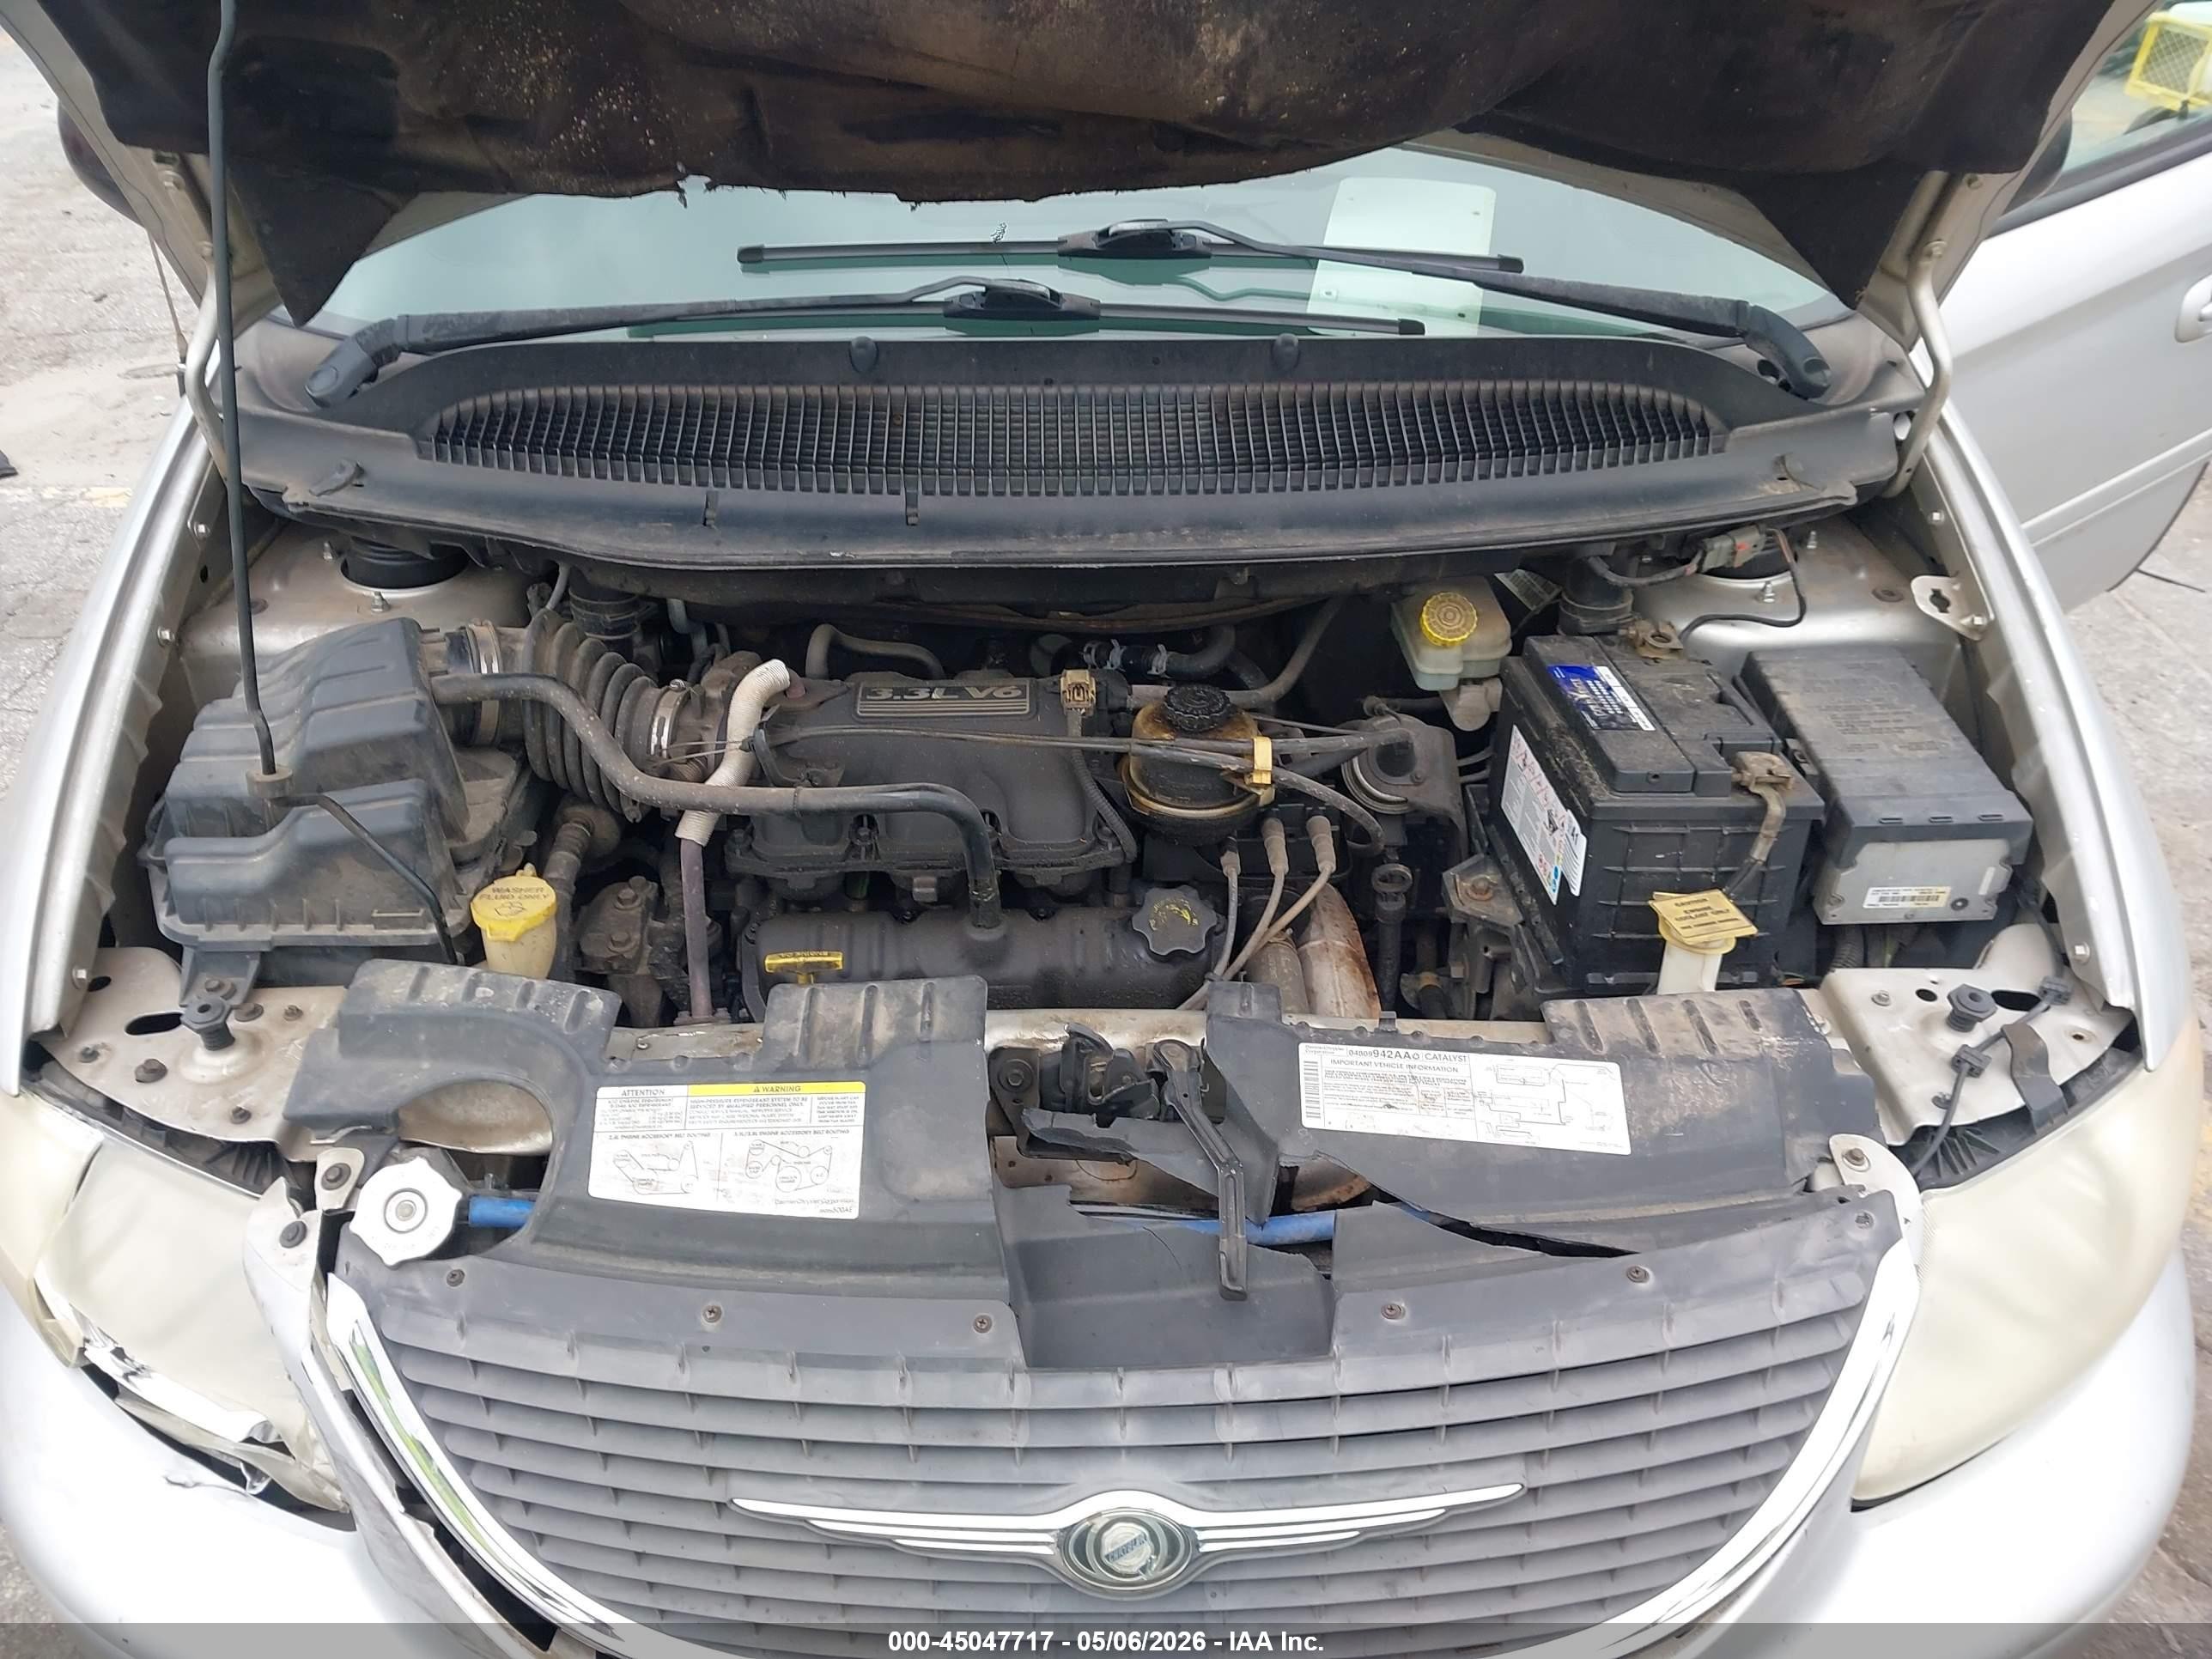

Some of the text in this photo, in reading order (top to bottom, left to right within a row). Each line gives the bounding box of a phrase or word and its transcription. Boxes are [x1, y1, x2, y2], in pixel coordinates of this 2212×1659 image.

[866, 685, 1022, 701] 3.3L V6
[1425, 1053, 1468, 1062] CATALYST
[1406, 1064, 1459, 1073] INFORMATION
